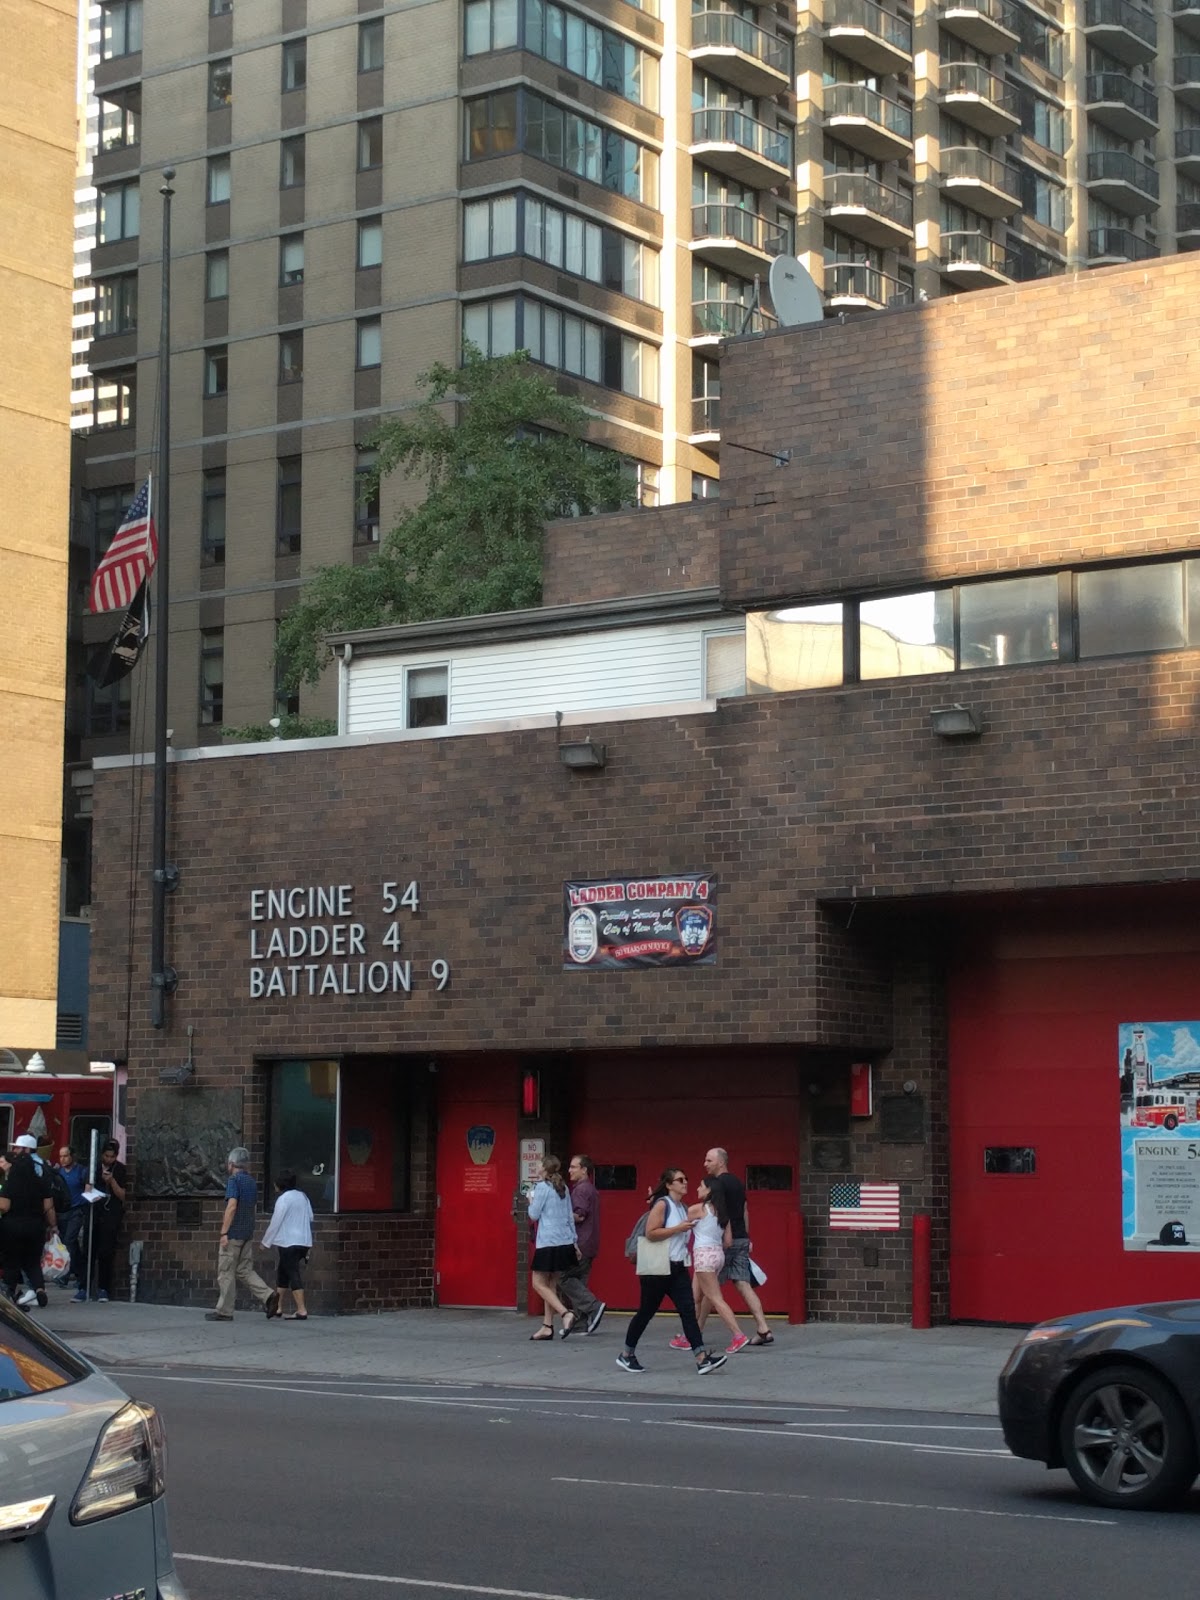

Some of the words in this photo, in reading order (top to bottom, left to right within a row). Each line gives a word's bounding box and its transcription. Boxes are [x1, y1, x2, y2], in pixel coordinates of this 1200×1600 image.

[251, 885, 353, 921] ENGINE
[382, 880, 419, 914] 54
[570, 884, 625, 906] LADDER
[627, 880, 696, 900] COMPANY
[696, 881, 709, 899] 4
[599, 909, 629, 922] Proudly
[631, 908, 660, 921] Serving
[662, 907, 674, 918] the
[603, 922, 621, 935] City
[622, 922, 632, 935] of
[632, 921, 651, 933] New
[653, 921, 673, 934] York
[251, 923, 366, 960] LADDER
[382, 921, 401, 953] 4
[250, 960, 411, 998] BATTALION
[431, 959, 449, 991] 9
[528, 1143, 536, 1151] NO
[1138, 1146, 1180, 1156] ENGINE
